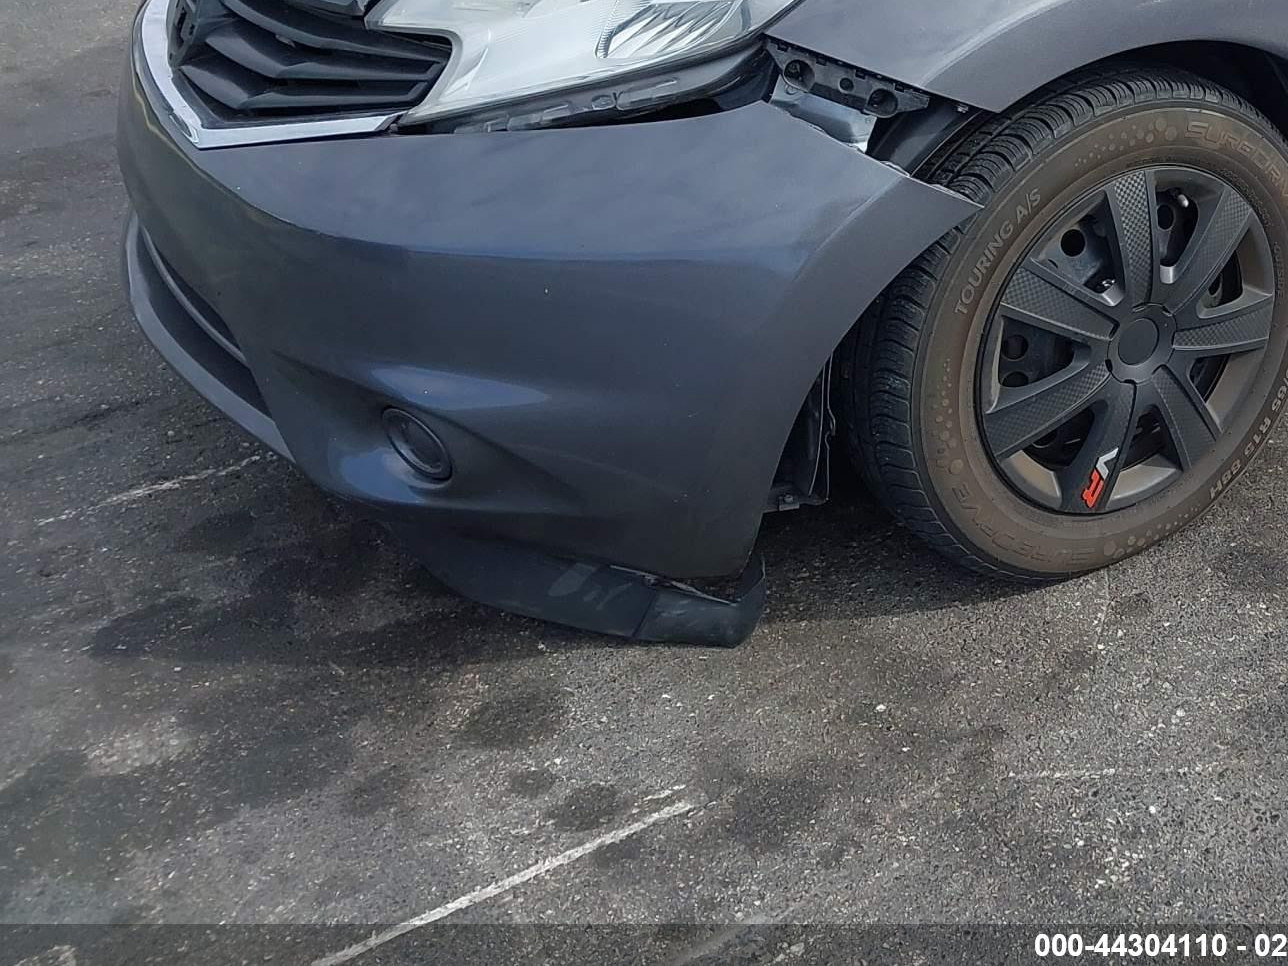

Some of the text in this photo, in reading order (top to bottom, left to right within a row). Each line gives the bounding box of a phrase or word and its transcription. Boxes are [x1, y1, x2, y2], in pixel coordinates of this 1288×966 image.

[954, 187, 1042, 315] TOURING A/S
[1243, 417, 1272, 457] R15
